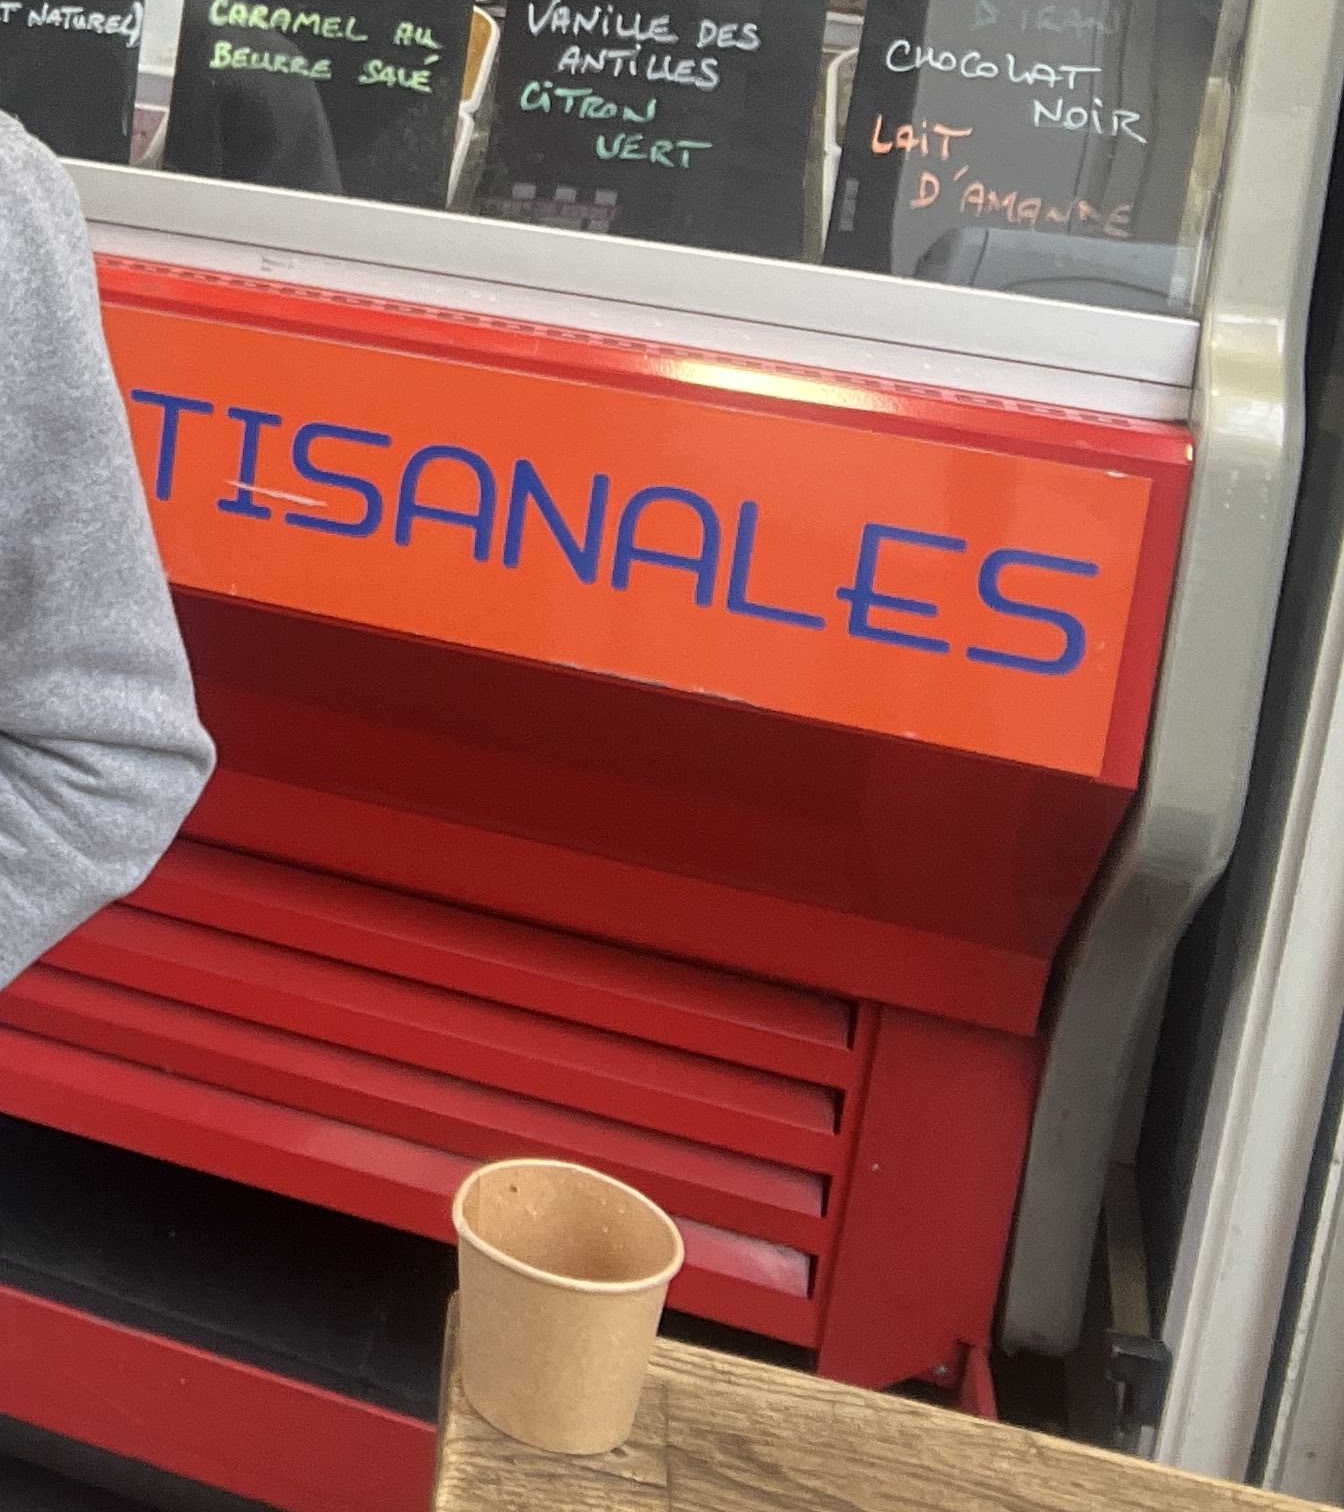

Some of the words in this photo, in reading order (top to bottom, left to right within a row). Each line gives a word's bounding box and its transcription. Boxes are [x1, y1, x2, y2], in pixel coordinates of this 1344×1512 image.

[392, 20, 444, 50] AU
[696, 19, 763, 53] DES
[208, 39, 333, 82] BEURRE
[886, 39, 1103, 91] CHOCOLAT
[594, 132, 714, 170] VERT
[130, 386, 1100, 678] TISANALES
